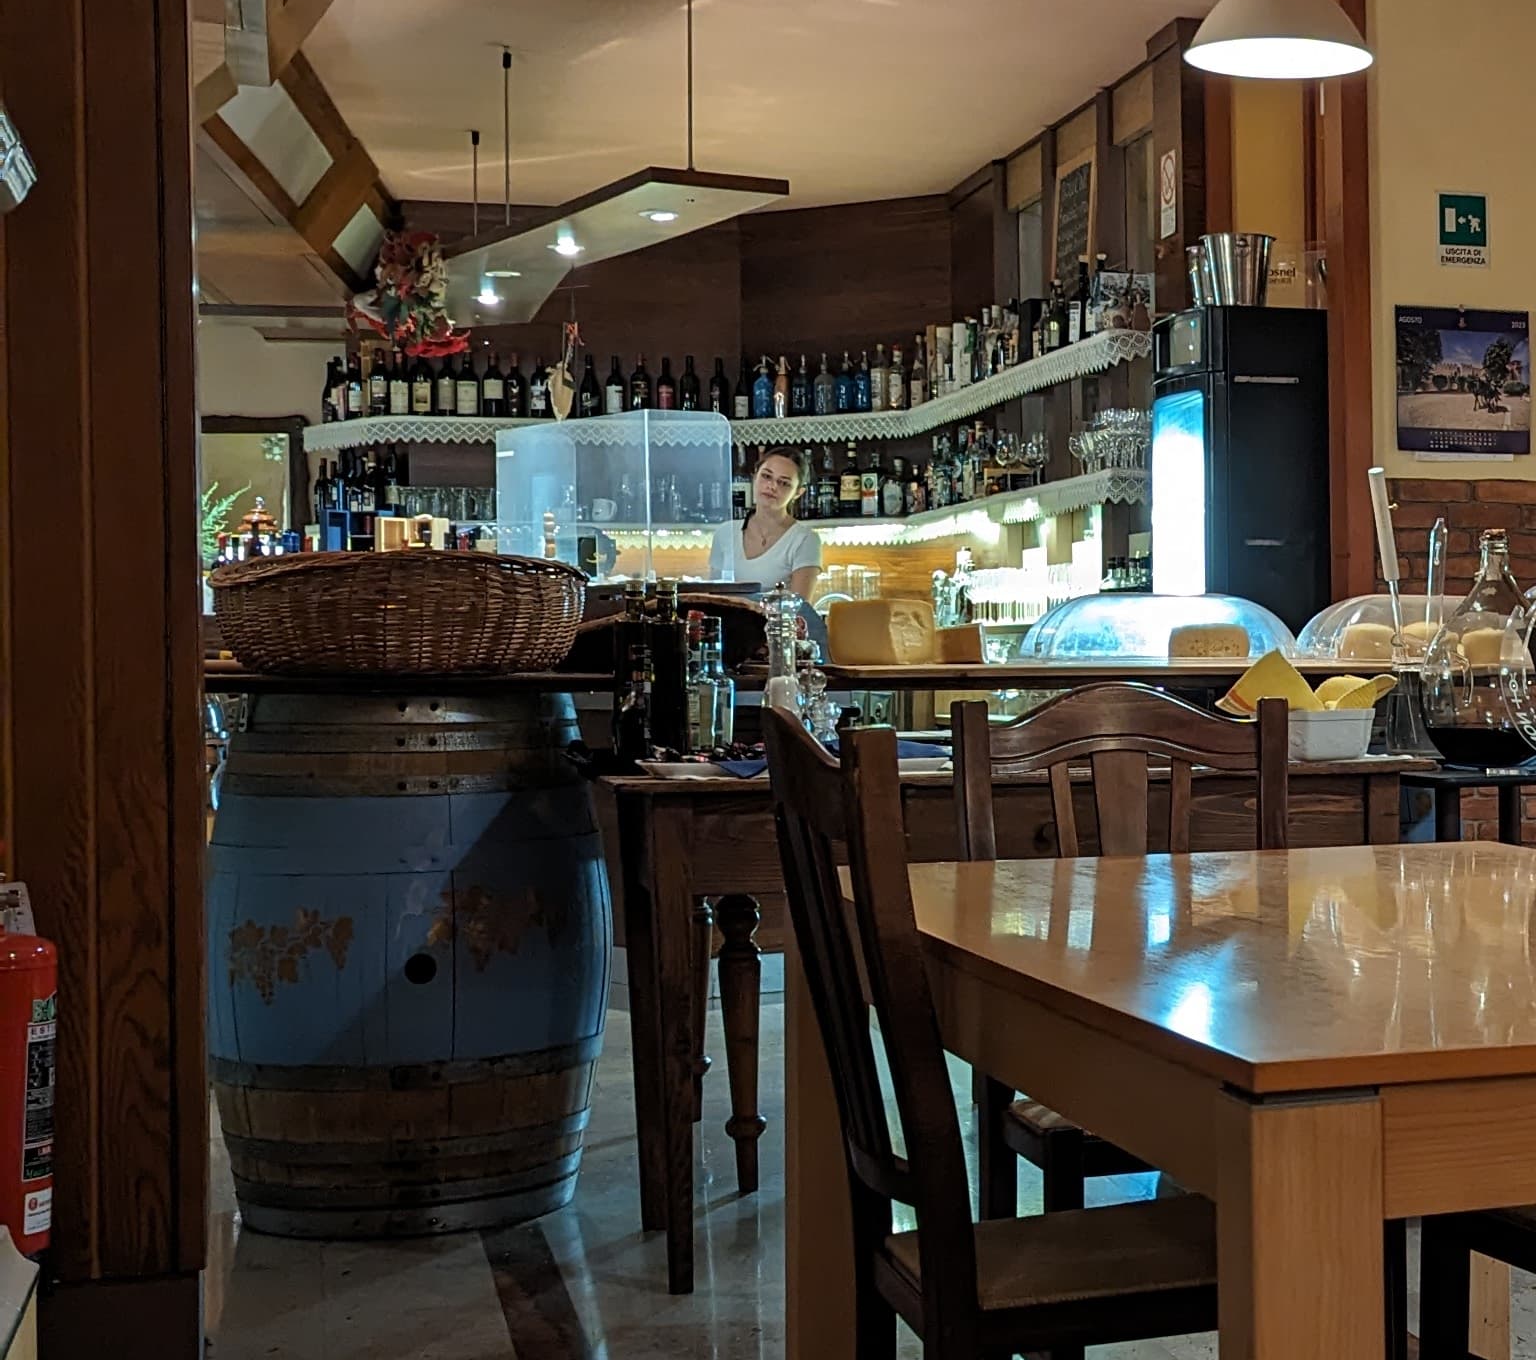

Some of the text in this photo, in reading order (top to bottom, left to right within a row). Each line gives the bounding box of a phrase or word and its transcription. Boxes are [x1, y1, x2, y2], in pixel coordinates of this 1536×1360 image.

[1445, 248, 1482, 257] USCITA DI
[1440, 256, 1486, 264] EMERGENZA
